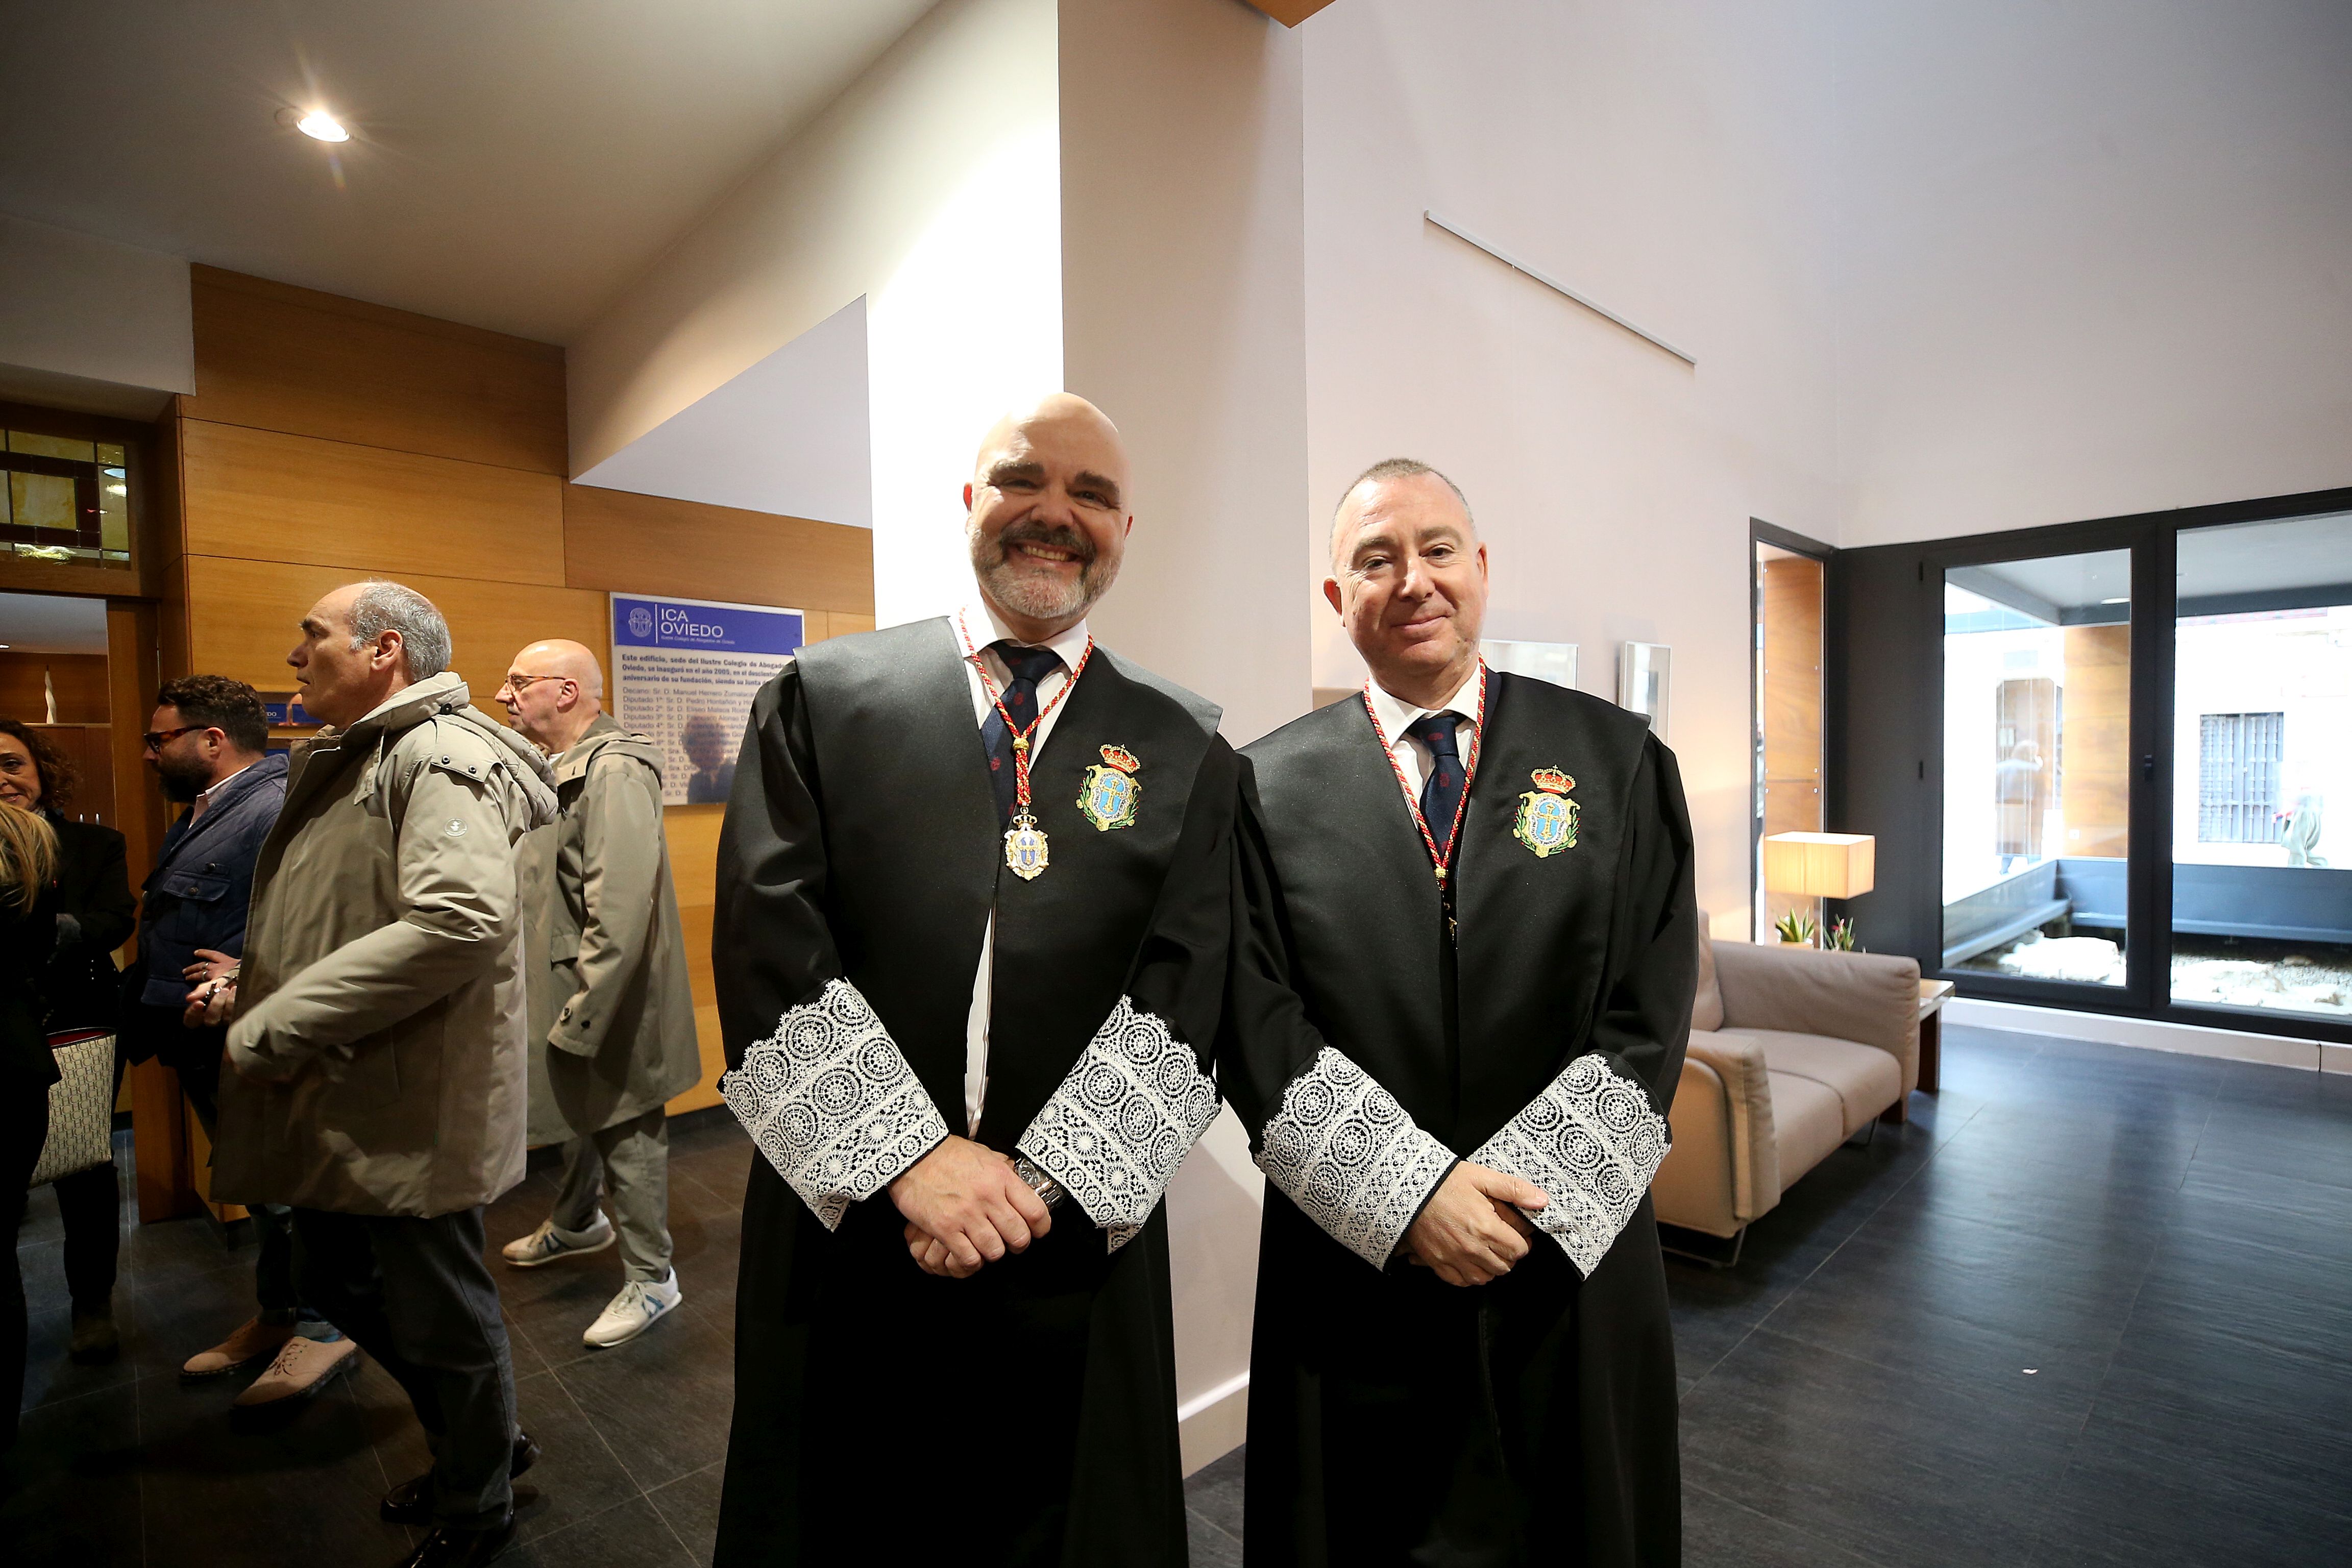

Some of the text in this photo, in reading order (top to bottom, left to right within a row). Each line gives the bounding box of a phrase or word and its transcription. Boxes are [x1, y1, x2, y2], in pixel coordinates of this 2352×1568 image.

[661, 608, 688, 622] ICA
[660, 621, 724, 638] OVIEDO
[656, 665, 684, 673] inauguró
[680, 676, 713, 684] fundación,
